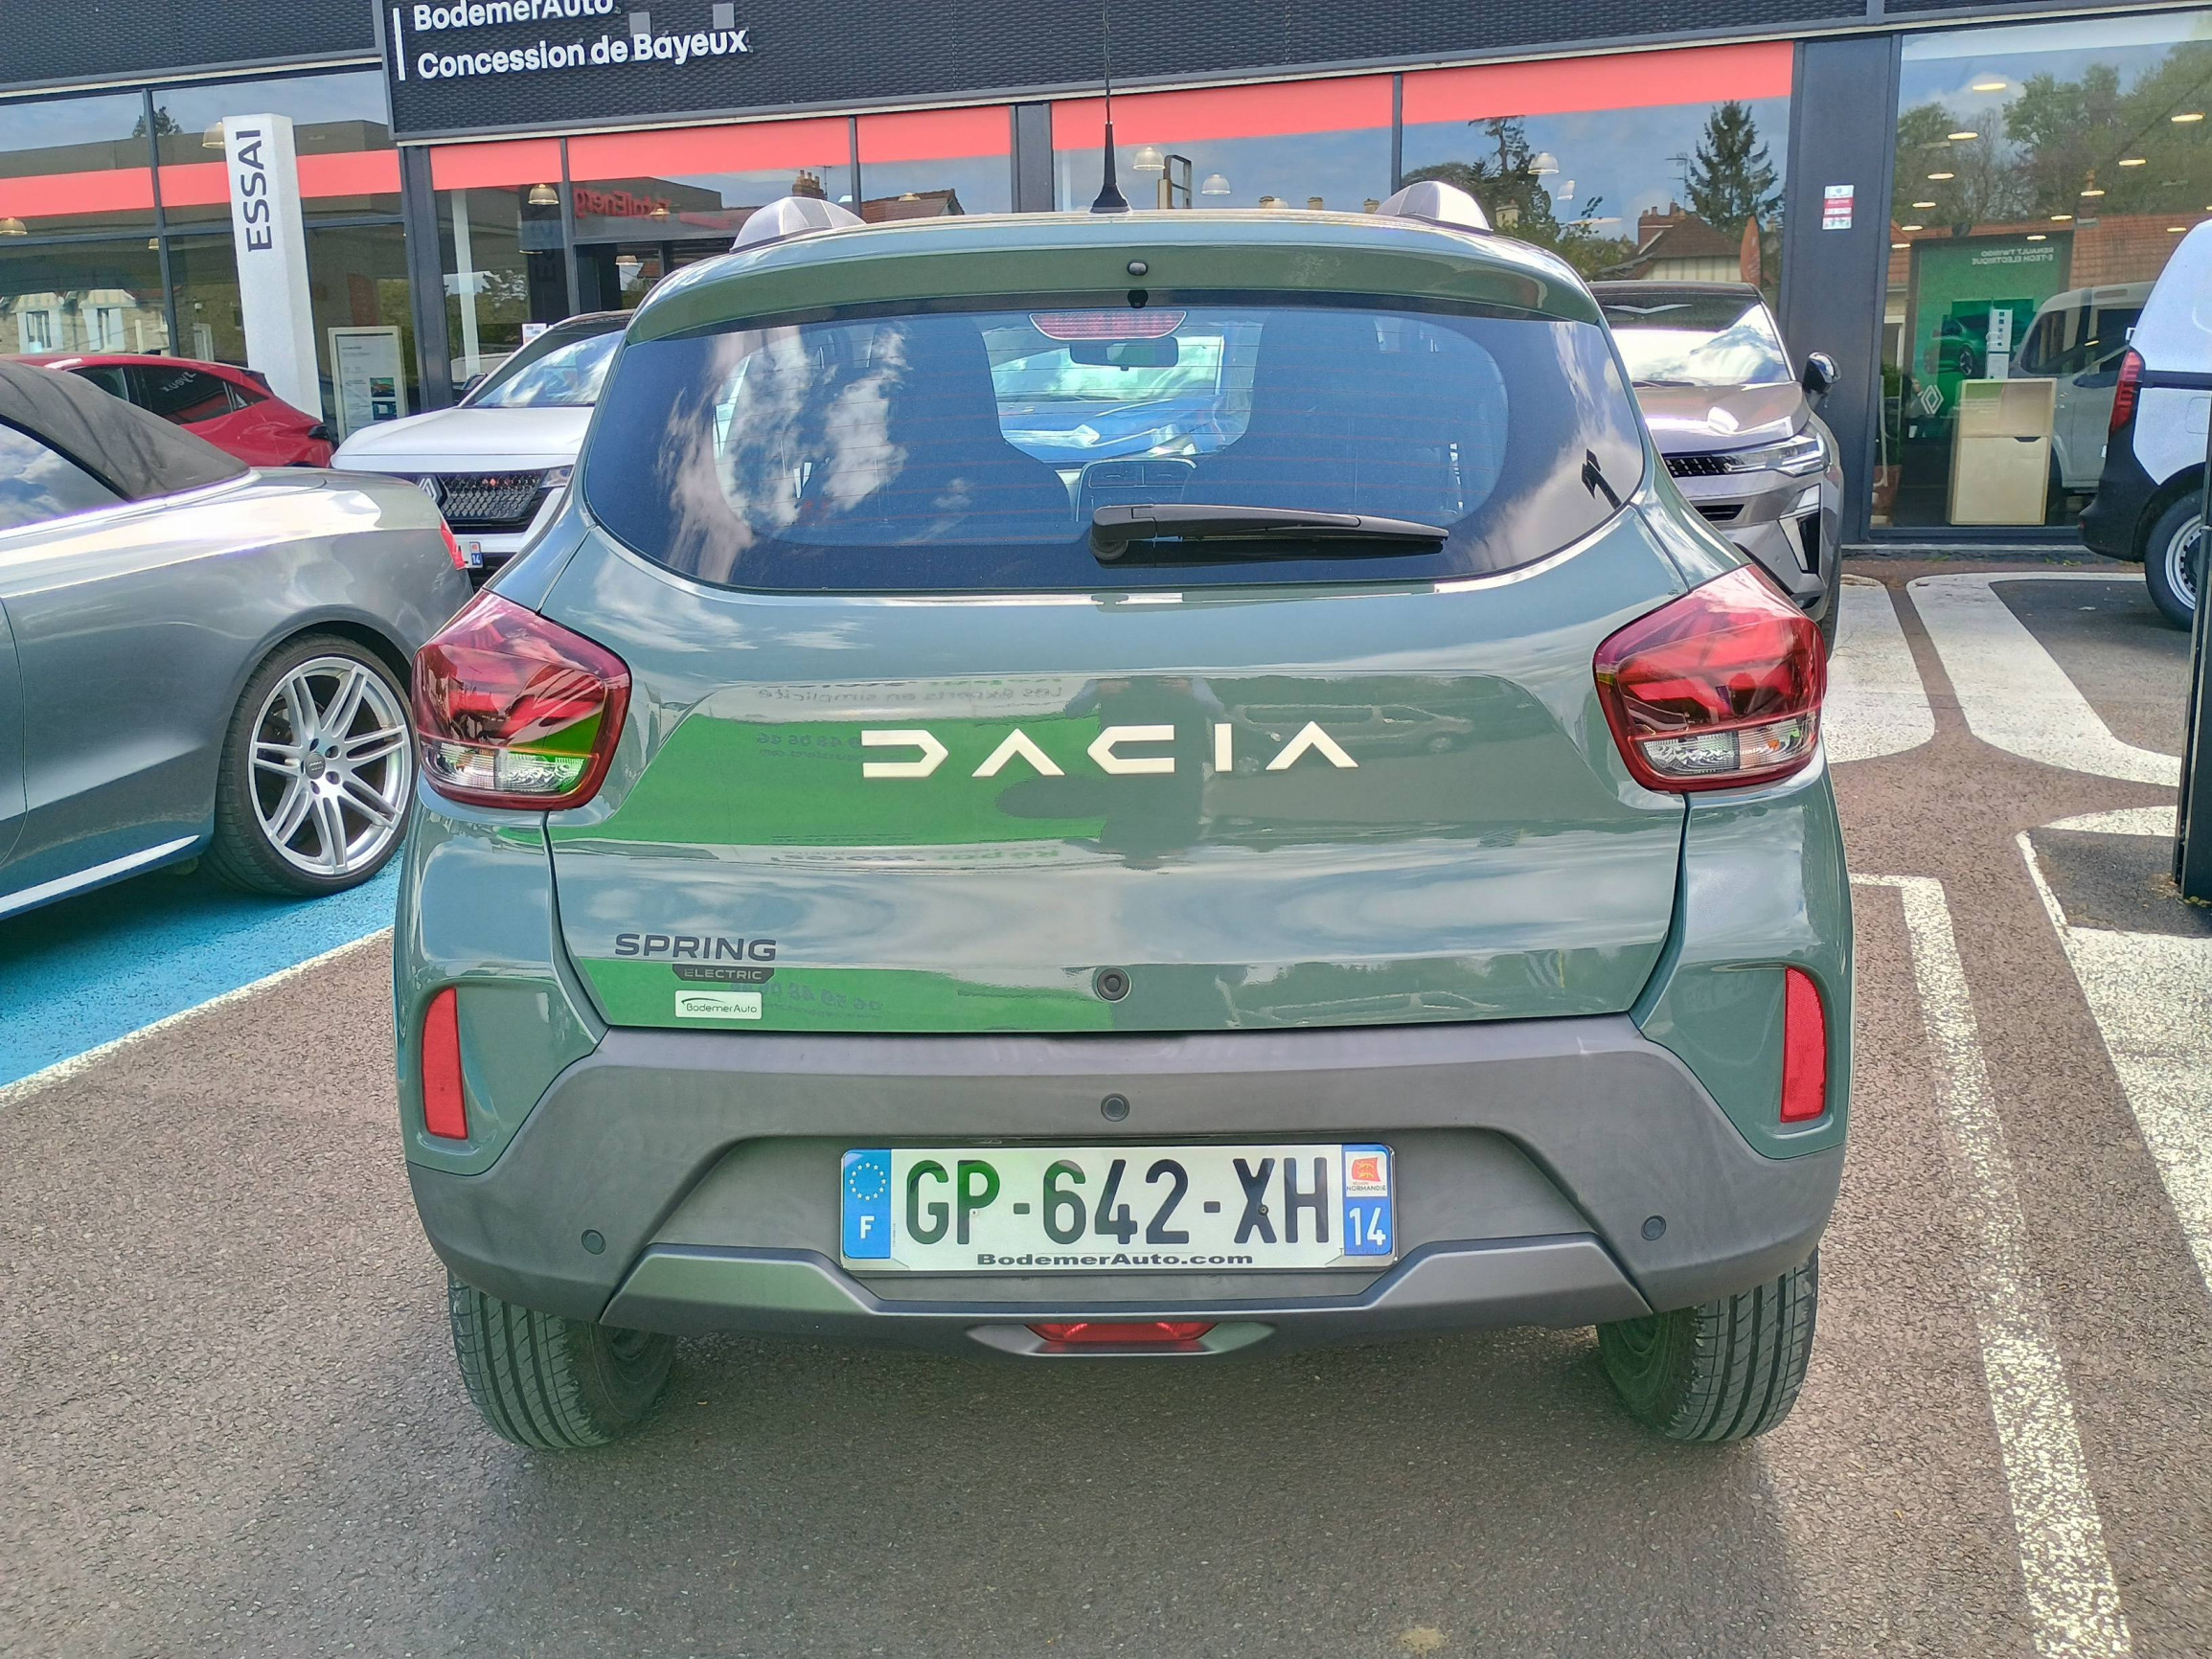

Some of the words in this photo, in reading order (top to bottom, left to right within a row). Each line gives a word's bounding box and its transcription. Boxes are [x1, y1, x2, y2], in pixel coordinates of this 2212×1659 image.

[418, 40, 585, 79] Concession
[590, 34, 628, 65] de
[633, 28, 749, 64] Bayeux
[235, 129, 273, 252] ESSAI
[861, 721, 1359, 778] DACIA
[614, 933, 777, 962] SPRING
[684, 967, 763, 981] ELECTRIC
[686, 1002, 758, 1013] BodemerAuto
[859, 1216, 875, 1239] F
[905, 1156, 1330, 1245] GP-642-XH
[1349, 1207, 1387, 1246] 14
[976, 1253, 1254, 1266] BodemerAuto.com
